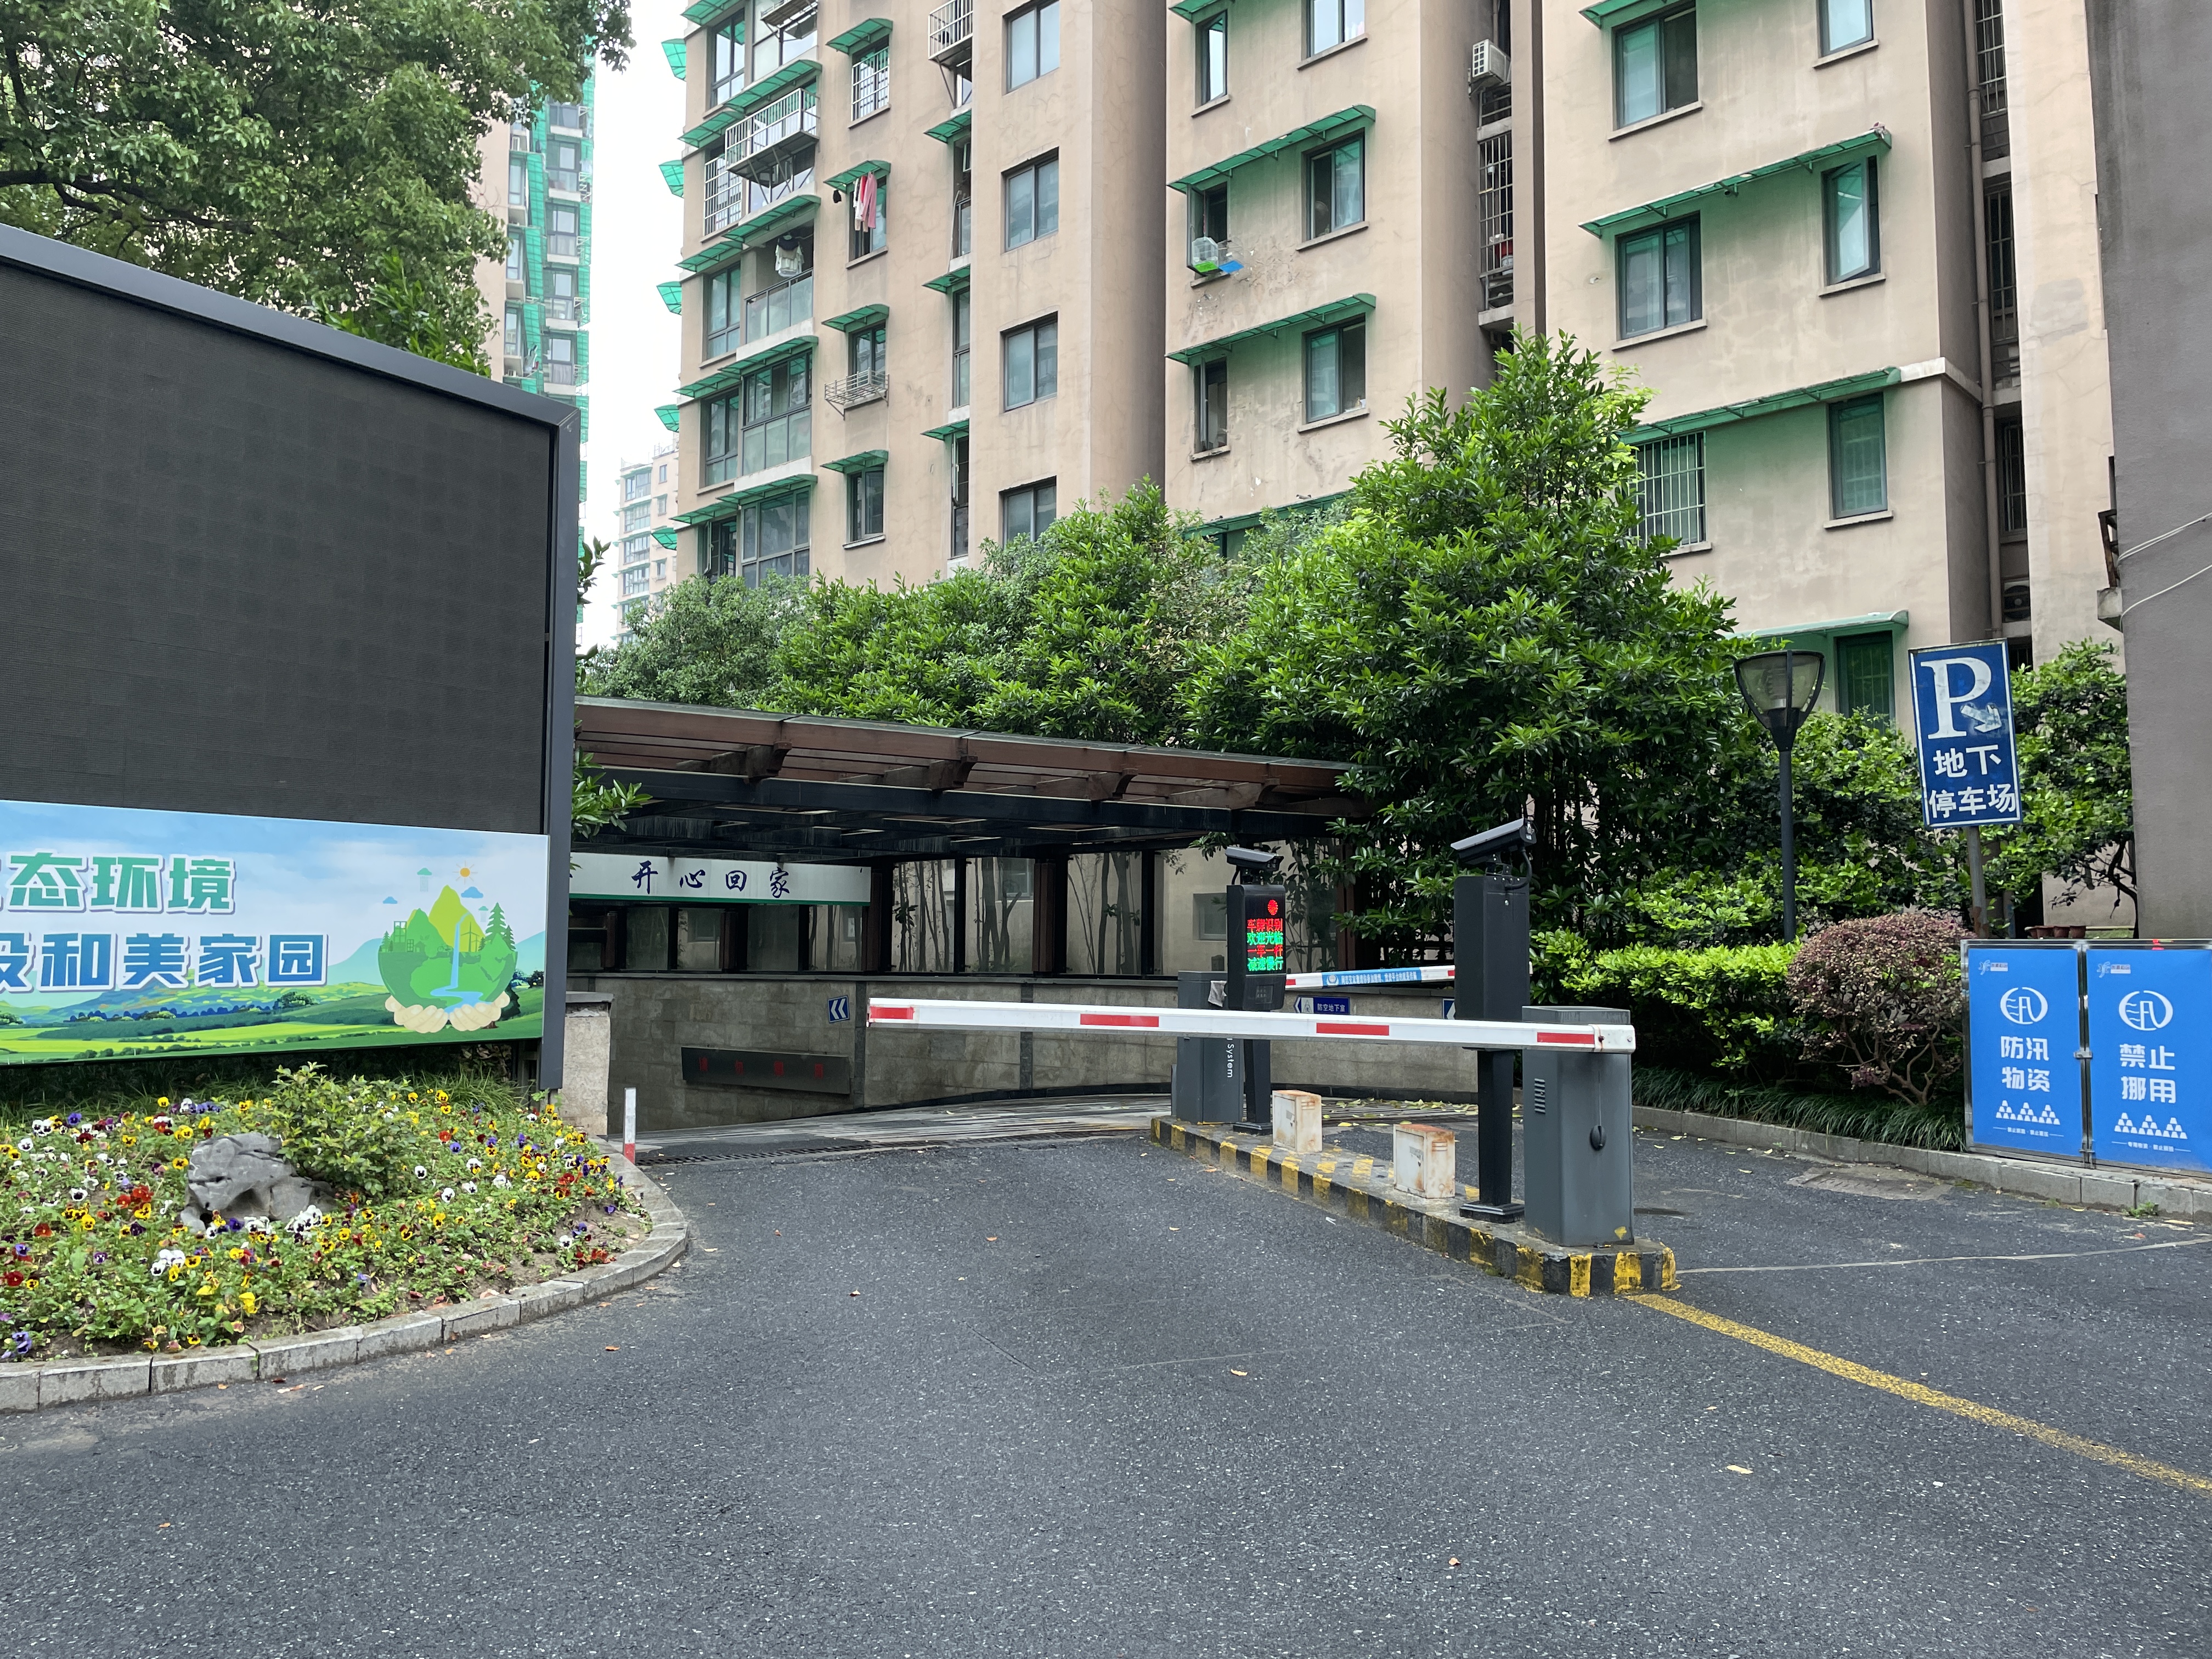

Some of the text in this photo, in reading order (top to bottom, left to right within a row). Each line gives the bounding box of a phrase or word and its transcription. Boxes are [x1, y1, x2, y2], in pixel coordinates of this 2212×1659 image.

[1921, 657, 1991, 739] P
[1933, 744, 2001, 777] 地下
[1929, 783, 2016, 819] 停车场
[631, 860, 790, 899] 开心回家
[1246, 931, 1284, 945] 欢迎光临
[1247, 918, 1283, 932] 车牌识别
[1247, 944, 1283, 957] 一车一杆
[1247, 956, 1284, 971] 减速慢行
[1317, 1003, 1345, 1012] 防空地下室
[1226, 1043, 1235, 1078] System
[2001, 1036, 2050, 1061] 防汛
[2119, 1043, 2175, 1070] 禁止
[2001, 1066, 2050, 1092] 物资
[2120, 1076, 2176, 1104] 挪用
